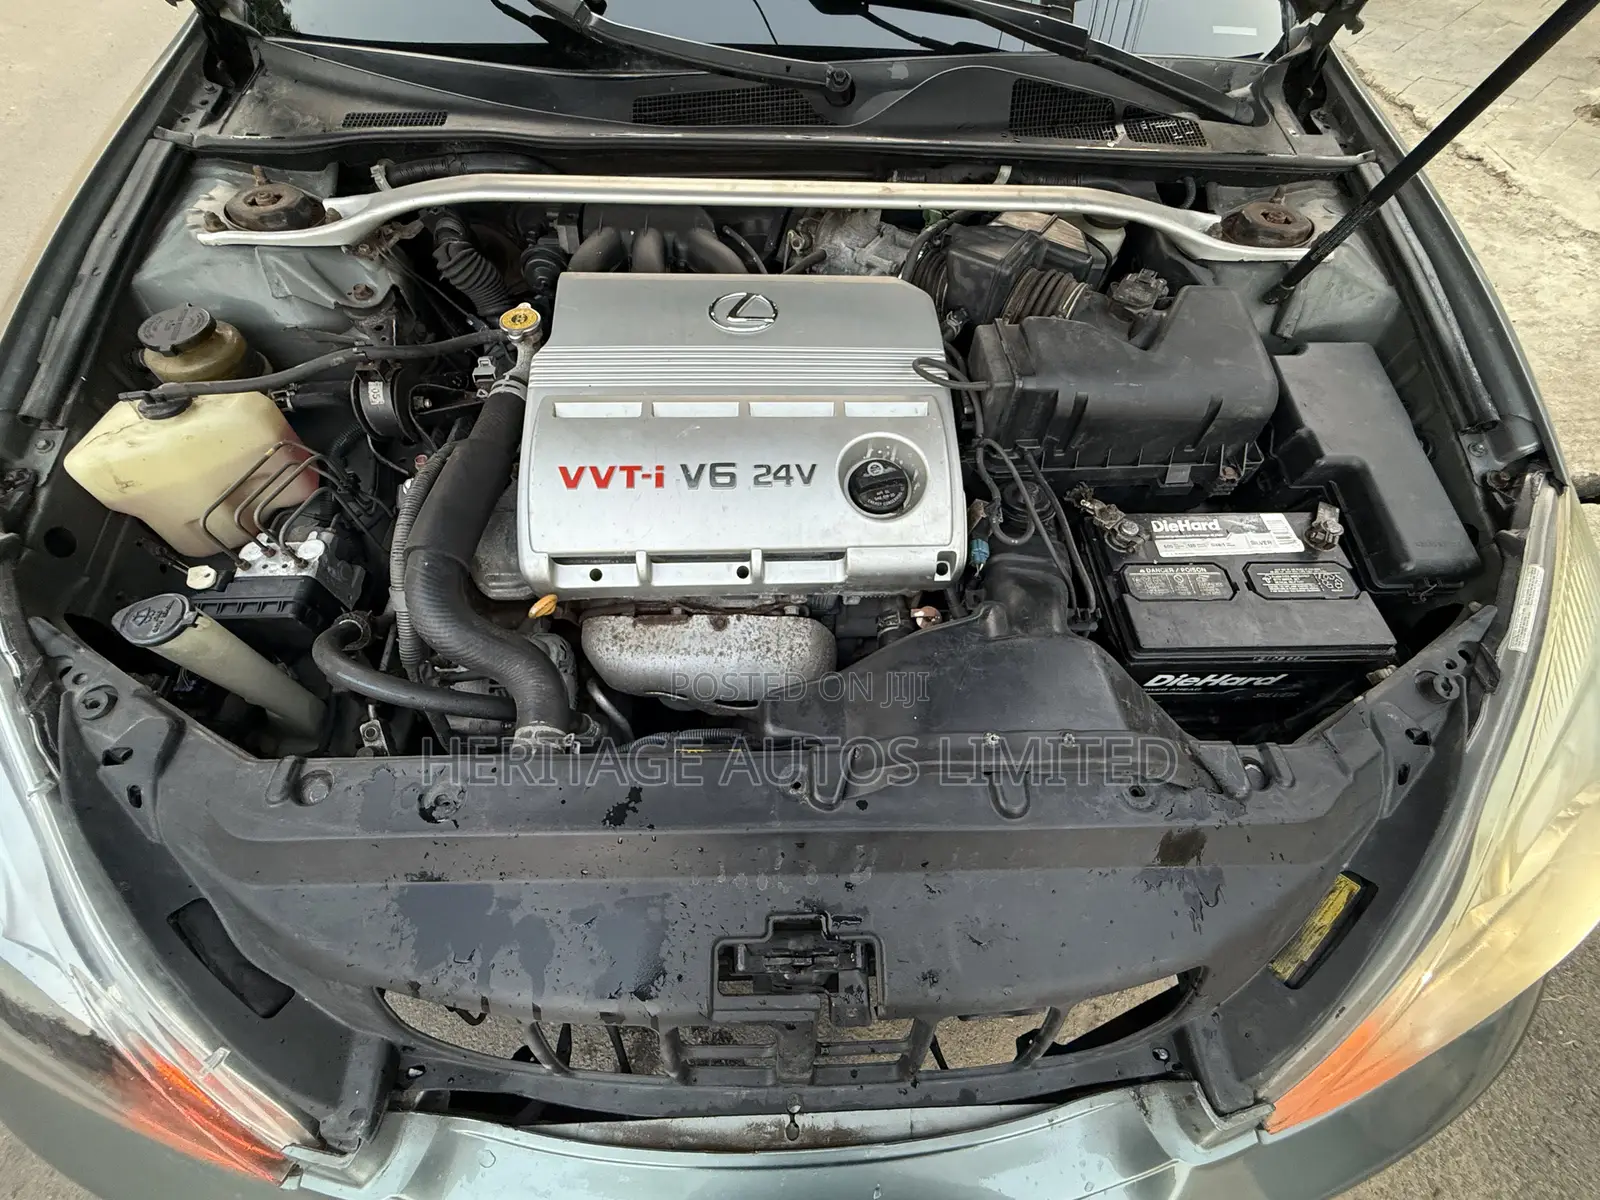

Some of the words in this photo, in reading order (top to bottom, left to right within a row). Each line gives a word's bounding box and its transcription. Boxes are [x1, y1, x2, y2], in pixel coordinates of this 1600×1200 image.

[558, 464, 665, 490] VVT-i
[680, 462, 738, 490] V6
[753, 463, 817, 488] 24V
[1150, 518, 1222, 533] DieHard
[1143, 673, 1289, 687] DieHard
